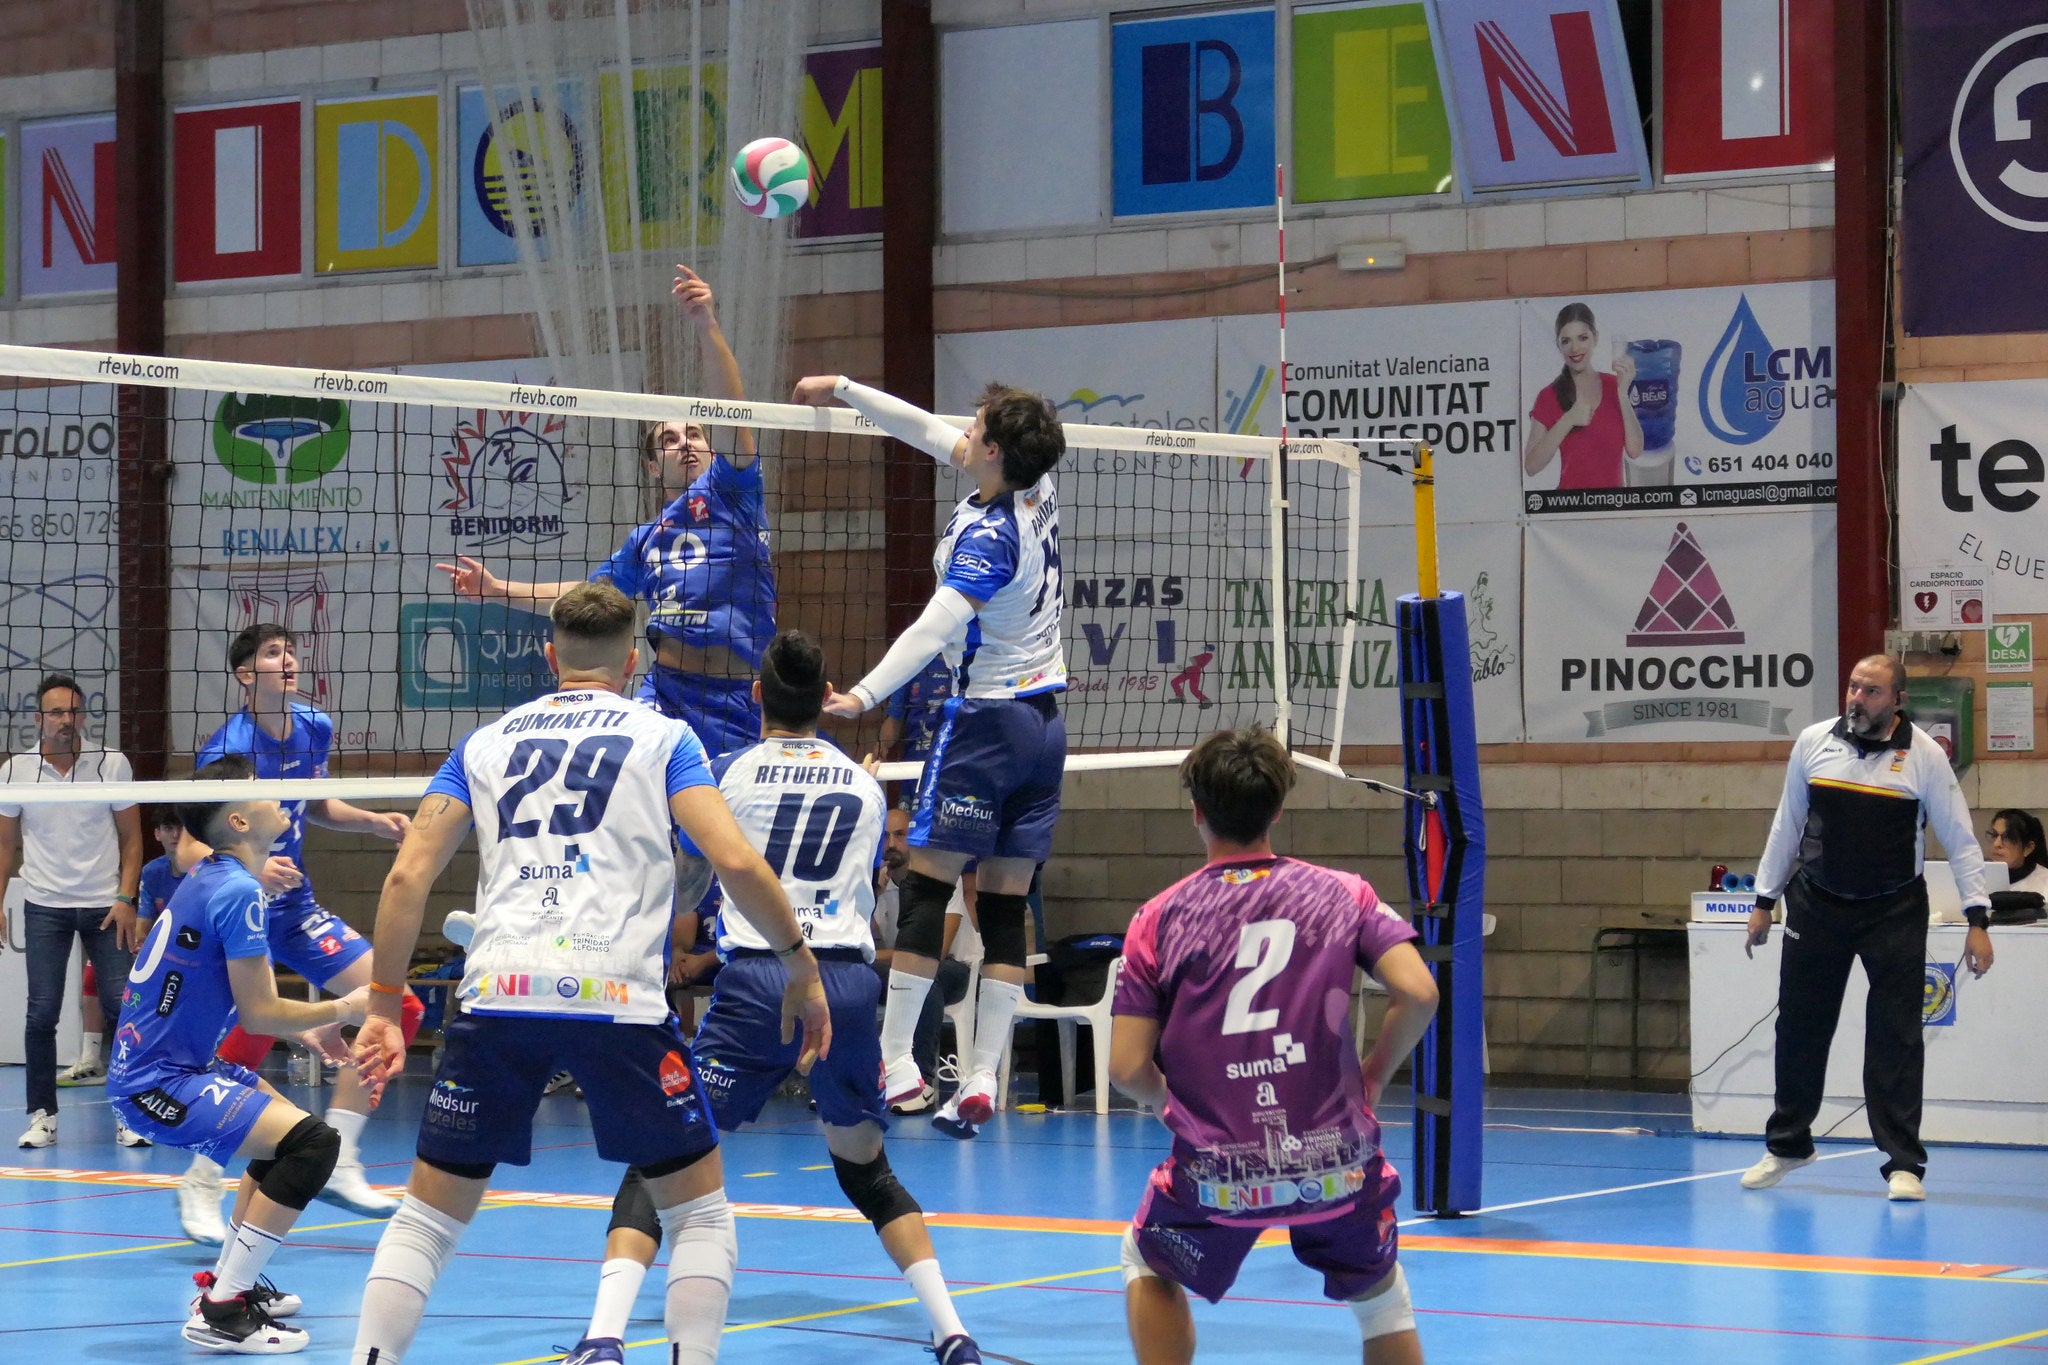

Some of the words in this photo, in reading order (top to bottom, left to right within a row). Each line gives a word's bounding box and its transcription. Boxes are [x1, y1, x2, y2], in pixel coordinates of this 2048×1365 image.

[98, 356, 180, 379] rfevb.com
[1284, 360, 1381, 382] Comunitat
[1386, 354, 1490, 377] Valenciana
[1744, 345, 1832, 383] LCM
[313, 373, 388, 394] rfevb.com
[509, 387, 578, 408] rfevb.com
[1284, 381, 1490, 422] COMUNITAT
[1744, 383, 1832, 421] agua
[689, 402, 753, 420] rfevb.com
[1145, 432, 1196, 448] rfevb.com
[1707, 456, 1743, 473] 651
[1752, 454, 1790, 471] 404
[1796, 452, 1834, 470] 040
[1930, 424, 2045, 513] te
[202, 485, 363, 510] MANTENIMIENTO
[1547, 491, 1674, 509] www.lcmagua.com
[31, 512, 75, 537] 850
[450, 514, 560, 537] BENIDORM
[222, 526, 344, 557] BENIALEX
[1959, 533, 1983, 561] EL
[1996, 550, 2046, 580] BUE
[1909, 579, 1984, 588] CARDIOPROTEGIDO
[1930, 571, 1963, 580] ESPACIO
[1062, 577, 1185, 609] NZAS
[1227, 578, 1389, 629] TAERNA
[1992, 648, 2027, 660] DESA
[1471, 655, 1506, 683] ablo
[1561, 652, 1814, 691] PINOCCHIO
[1066, 676, 1110, 693] Desde
[1118, 675, 1160, 692] 1983
[502, 709, 630, 735] CUMINETTI
[1633, 701, 1692, 721] SINCE
[1697, 701, 1739, 719] 1981
[754, 765, 853, 785] RETUERTO
[497, 735, 634, 844] 29
[942, 801, 994, 821] Medsur
[764, 792, 863, 882] 10
[519, 864, 574, 881] suma
[1706, 902, 1756, 914] MONDO
[572, 945, 610, 953] ALFONSO
[573, 938, 610, 947] TRINIDAD
[1222, 919, 1297, 1035] 2
[1225, 1056, 1288, 1080] suma
[429, 1088, 479, 1114] Medsur
[1197, 1165, 1366, 1213] BENIDORM
